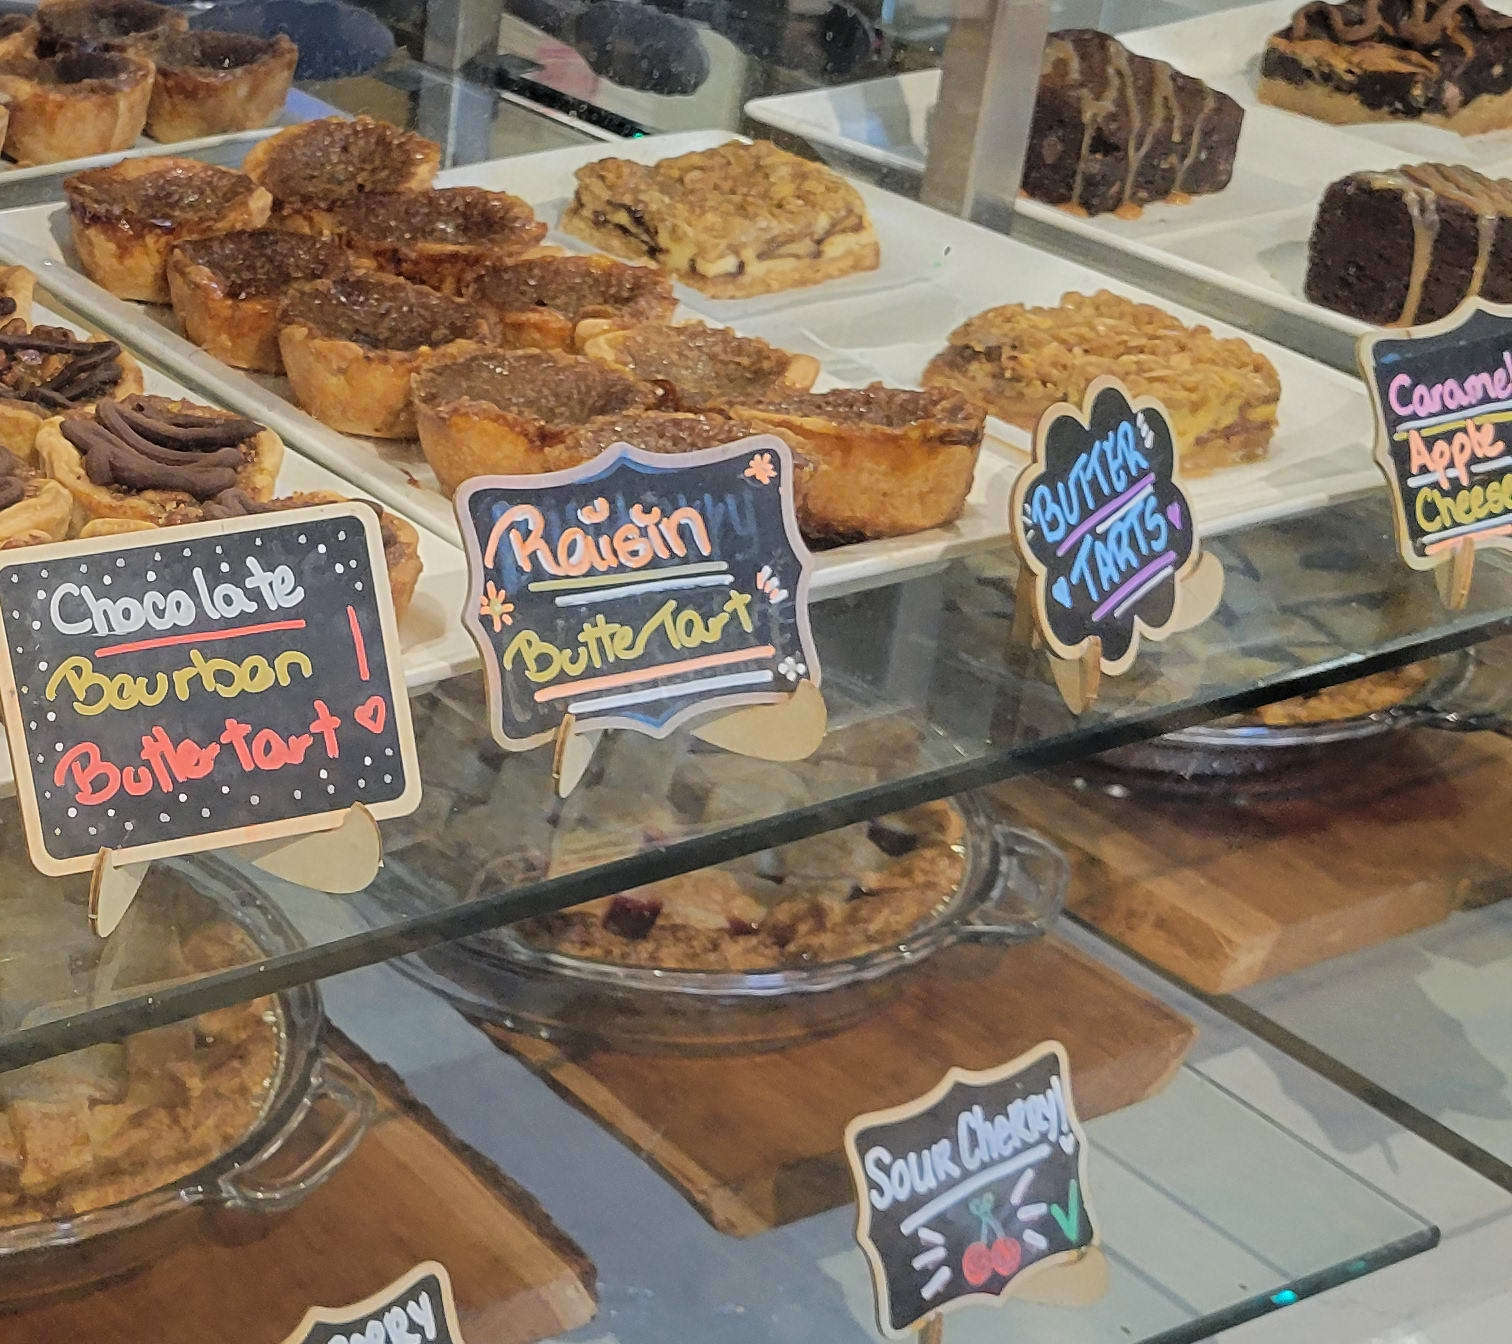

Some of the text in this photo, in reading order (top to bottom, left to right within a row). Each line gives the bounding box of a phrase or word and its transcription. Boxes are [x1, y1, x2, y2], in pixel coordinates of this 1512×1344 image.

[1031, 420, 1149, 543] BUTTER
[1408, 418, 1505, 490] Apple
[485, 497, 711, 577] Raisin
[1070, 495, 1168, 602] TARTS
[50, 557, 305, 637] Chocolate
[46, 650, 312, 715] Bourbon
